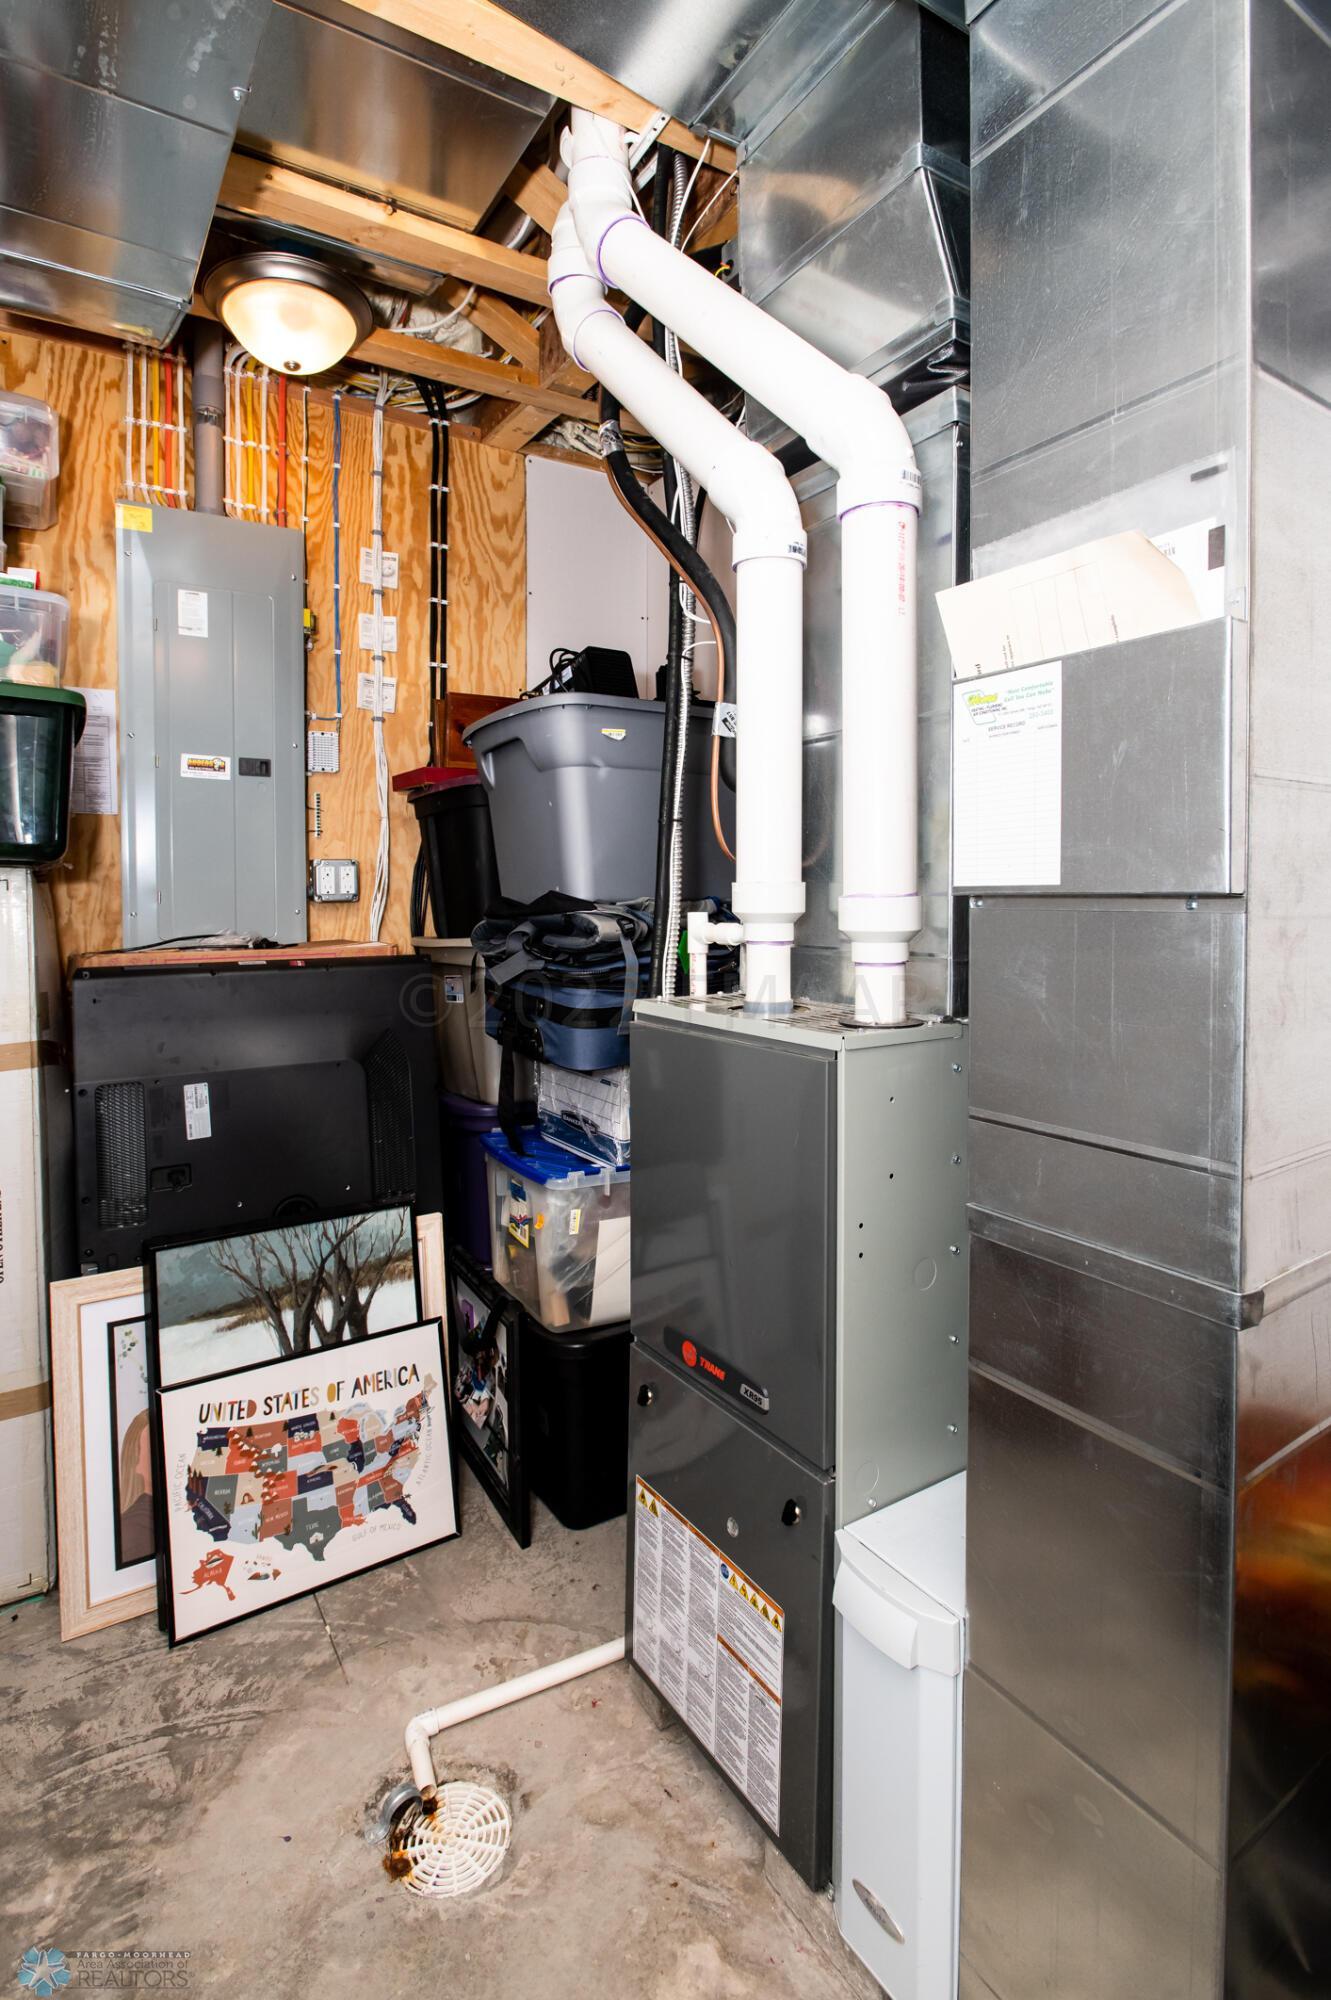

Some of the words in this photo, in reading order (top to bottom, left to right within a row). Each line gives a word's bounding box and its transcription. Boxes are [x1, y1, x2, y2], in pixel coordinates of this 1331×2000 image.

[699, 1356, 726, 1381] TRANE
[198, 1399, 257, 1424] UNITED
[263, 1386, 320, 1416] STATES
[327, 1381, 345, 1403] OF
[351, 1363, 420, 1398] AMERICA
[743, 1386, 763, 1406] XR95
